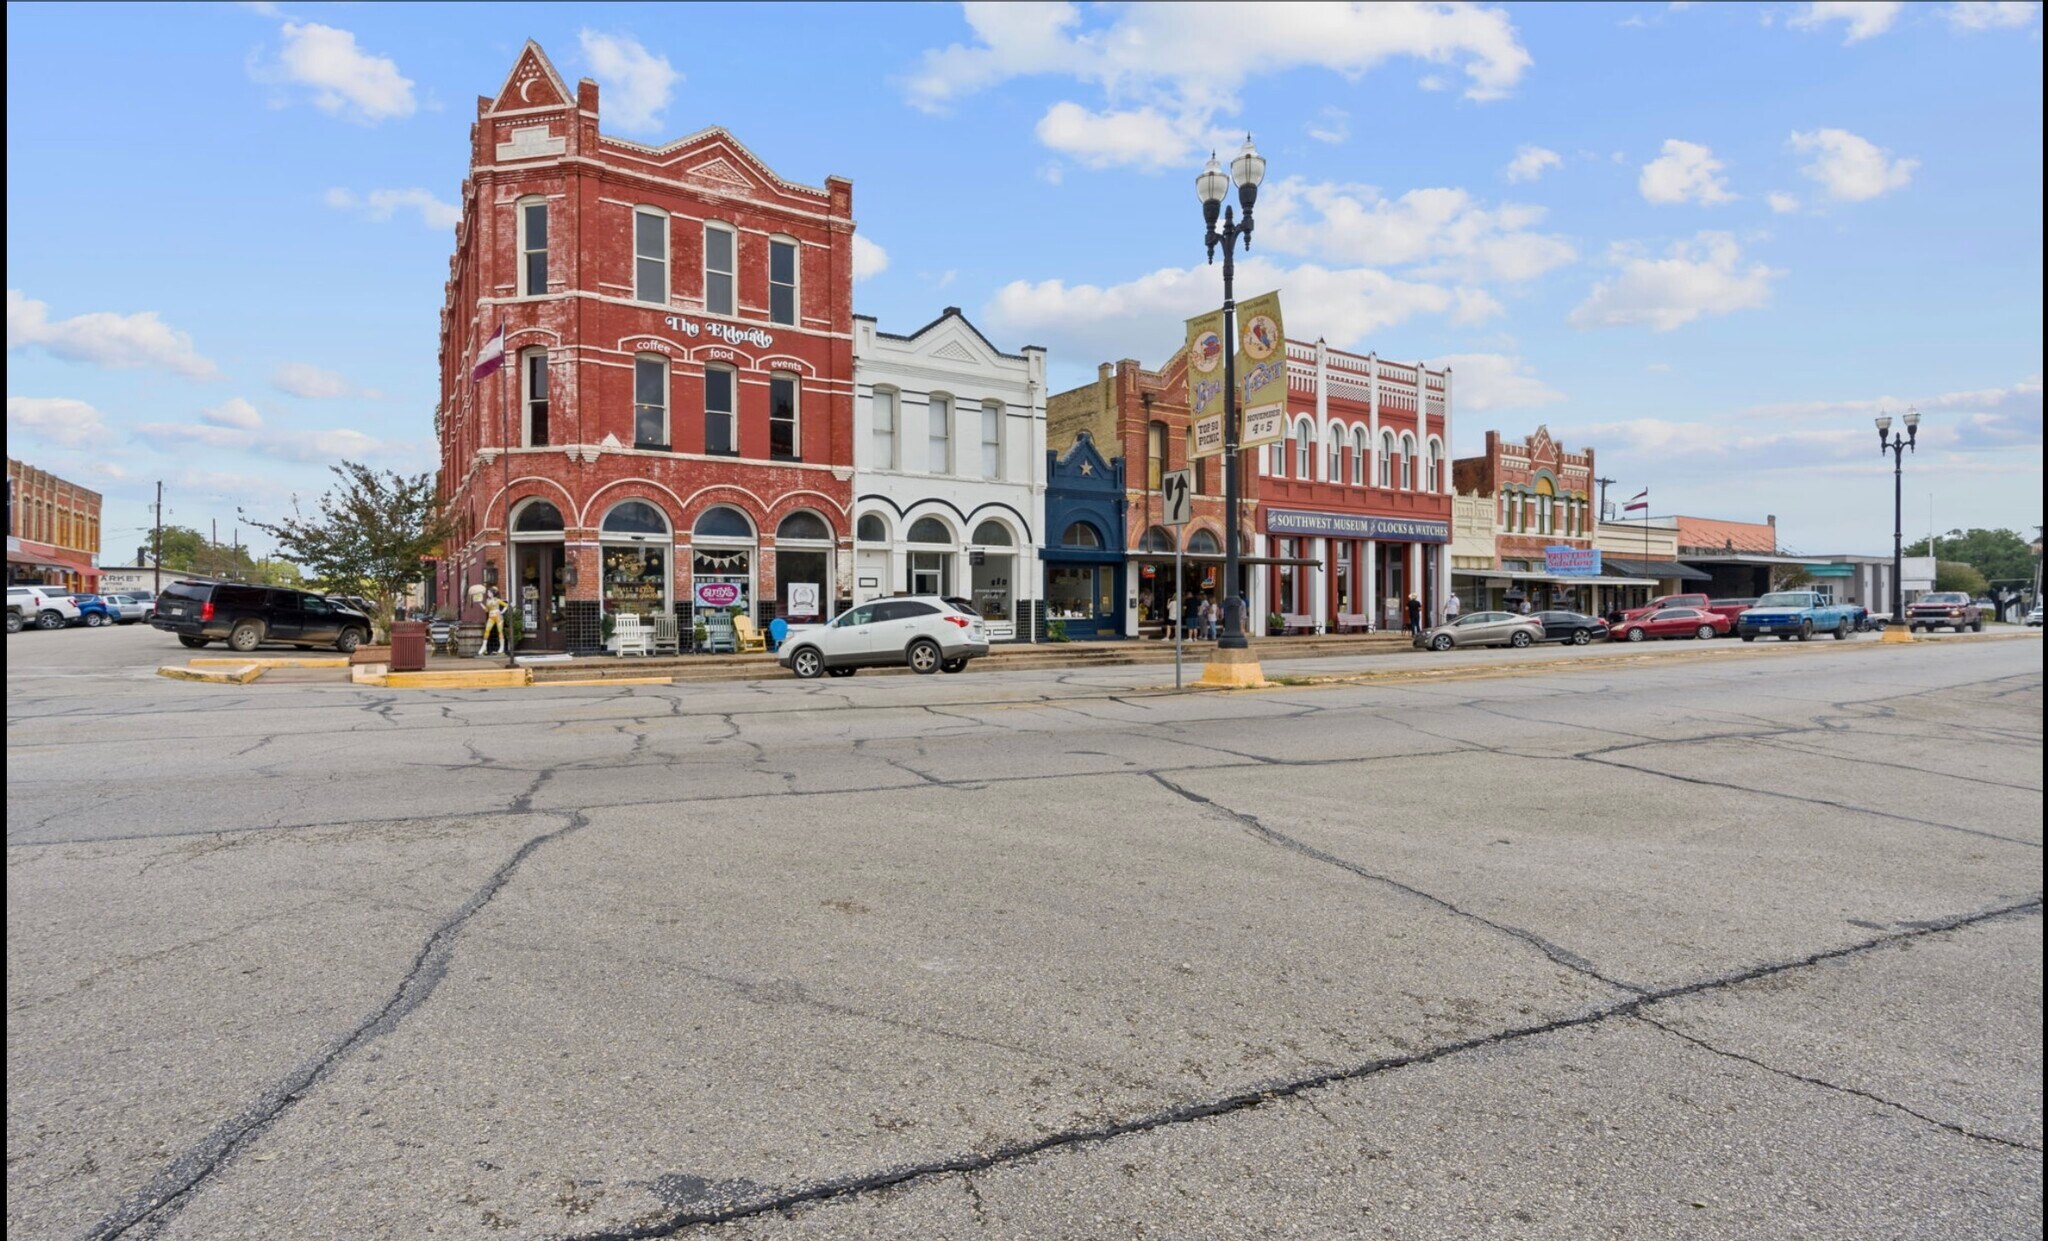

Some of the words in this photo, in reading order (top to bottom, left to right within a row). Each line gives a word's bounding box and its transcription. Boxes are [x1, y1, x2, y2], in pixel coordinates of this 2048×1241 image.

[665, 316, 700, 337] The
[704, 322, 773, 349] Eldorado
[637, 340, 671, 354] coffee
[709, 348, 734, 361] food
[771, 360, 802, 372] events
[1198, 422, 1211, 434] TOP
[1252, 423, 1259, 434] 4
[1266, 421, 1273, 432] 5
[1198, 432, 1220, 446] PICNIC
[1277, 514, 1332, 529] SOUTHWEST
[1333, 518, 1368, 532] MUSEUM
[1378, 521, 1408, 534] CLOCKS
[1408, 524, 1414, 534] &
[1415, 524, 1449, 537] WATCHES
